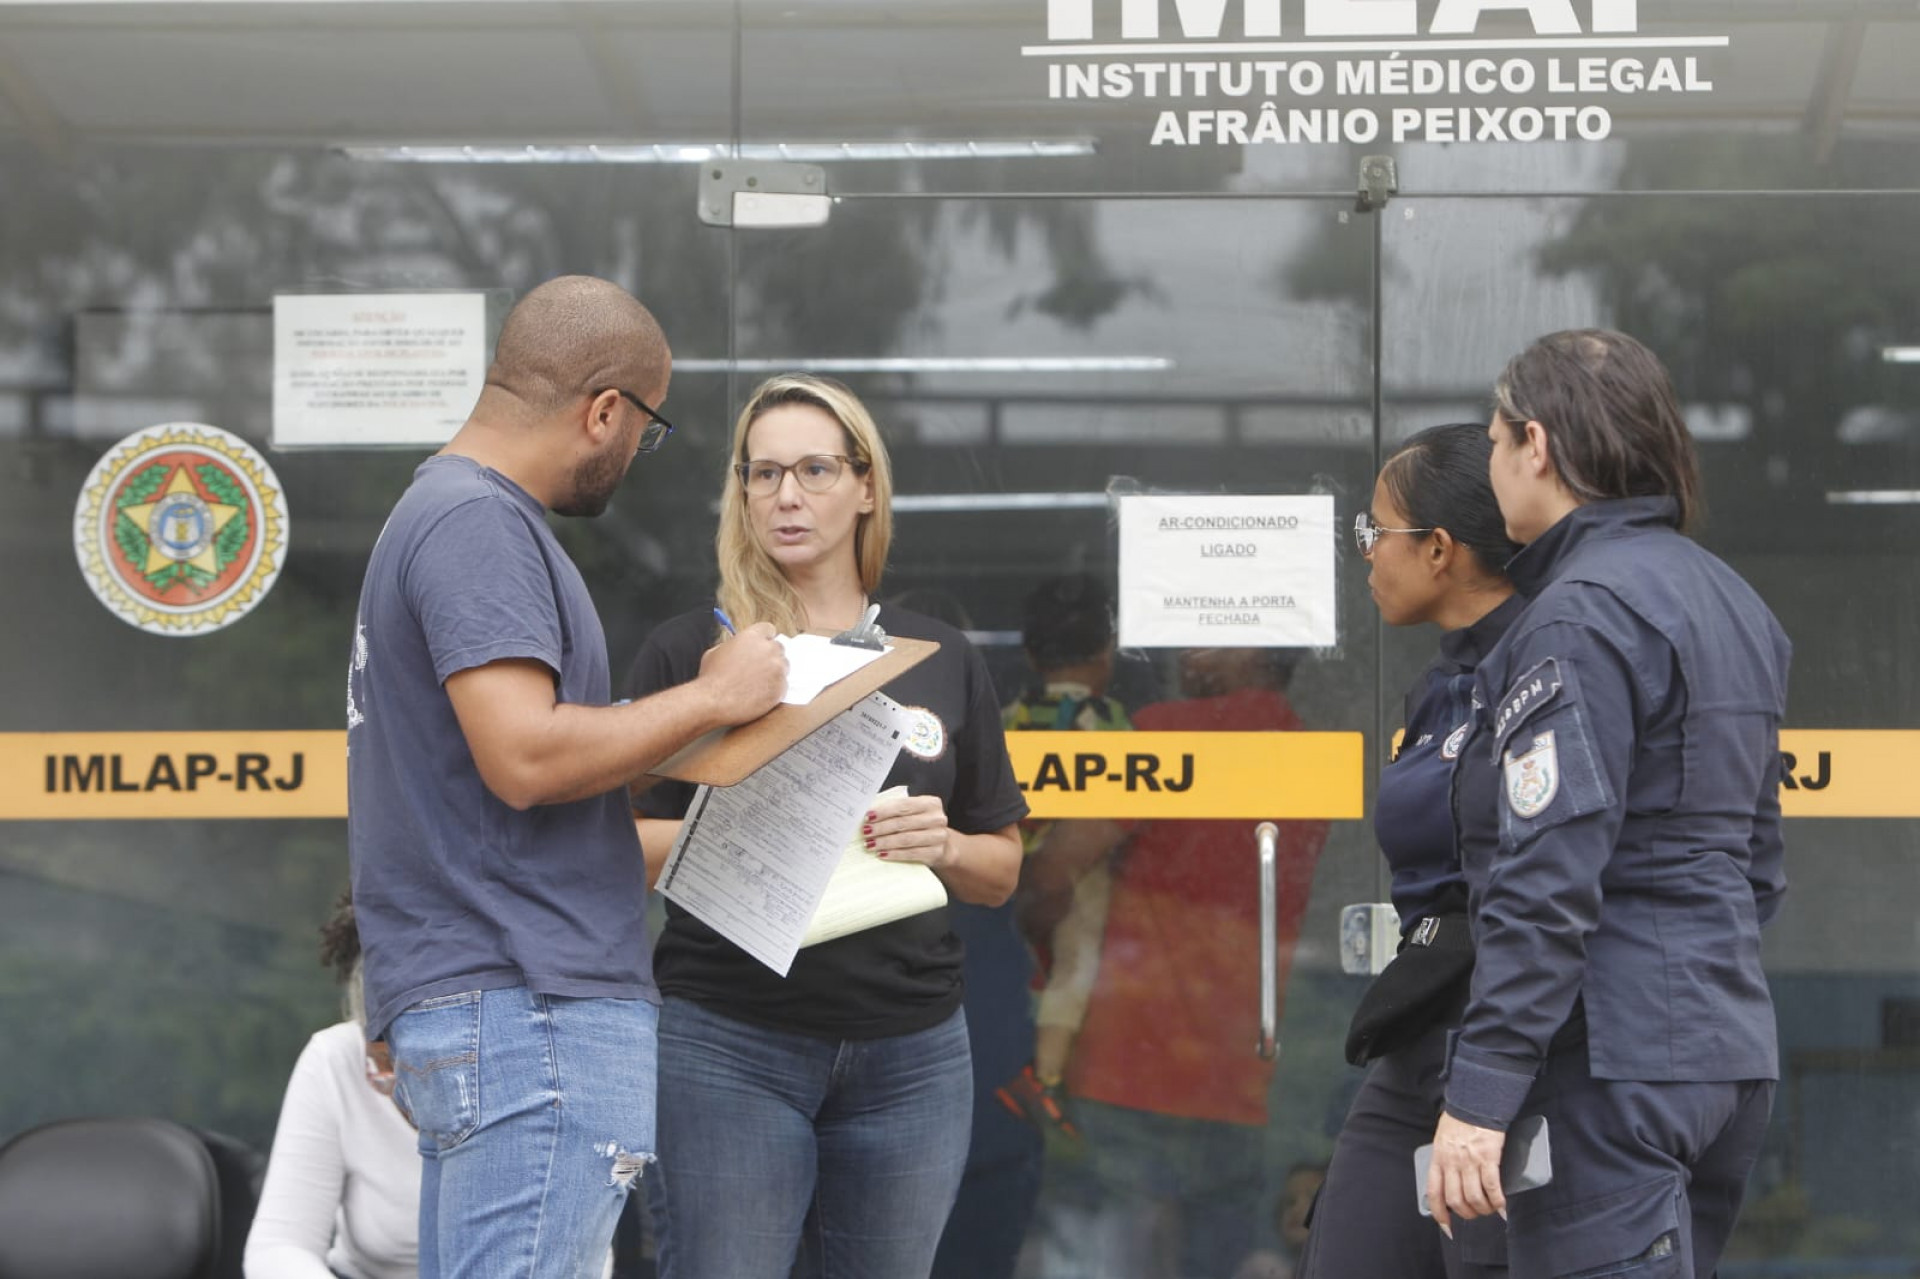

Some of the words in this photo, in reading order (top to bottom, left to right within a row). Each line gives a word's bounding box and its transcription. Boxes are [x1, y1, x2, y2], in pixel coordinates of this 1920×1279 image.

[1048, 60, 1324, 99] INSTITUTO
[1337, 53, 1535, 95] MÉDICO
[1548, 56, 1712, 93] LEGAL
[1150, 102, 1379, 146] AFRÂNIO
[1392, 105, 1612, 143] PEIXOTO
[1159, 516, 1299, 529] AR-CONDICIONADO
[1200, 543, 1257, 557] LIGADO
[1163, 596, 1235, 608] MANTENHA
[1240, 597, 1249, 607] A
[1252, 595, 1296, 607] PORTA
[1199, 612, 1260, 624] FECHADA
[45, 752, 304, 793] IMLAP-RJ
[1018, 753, 1194, 792] AP-RJ
